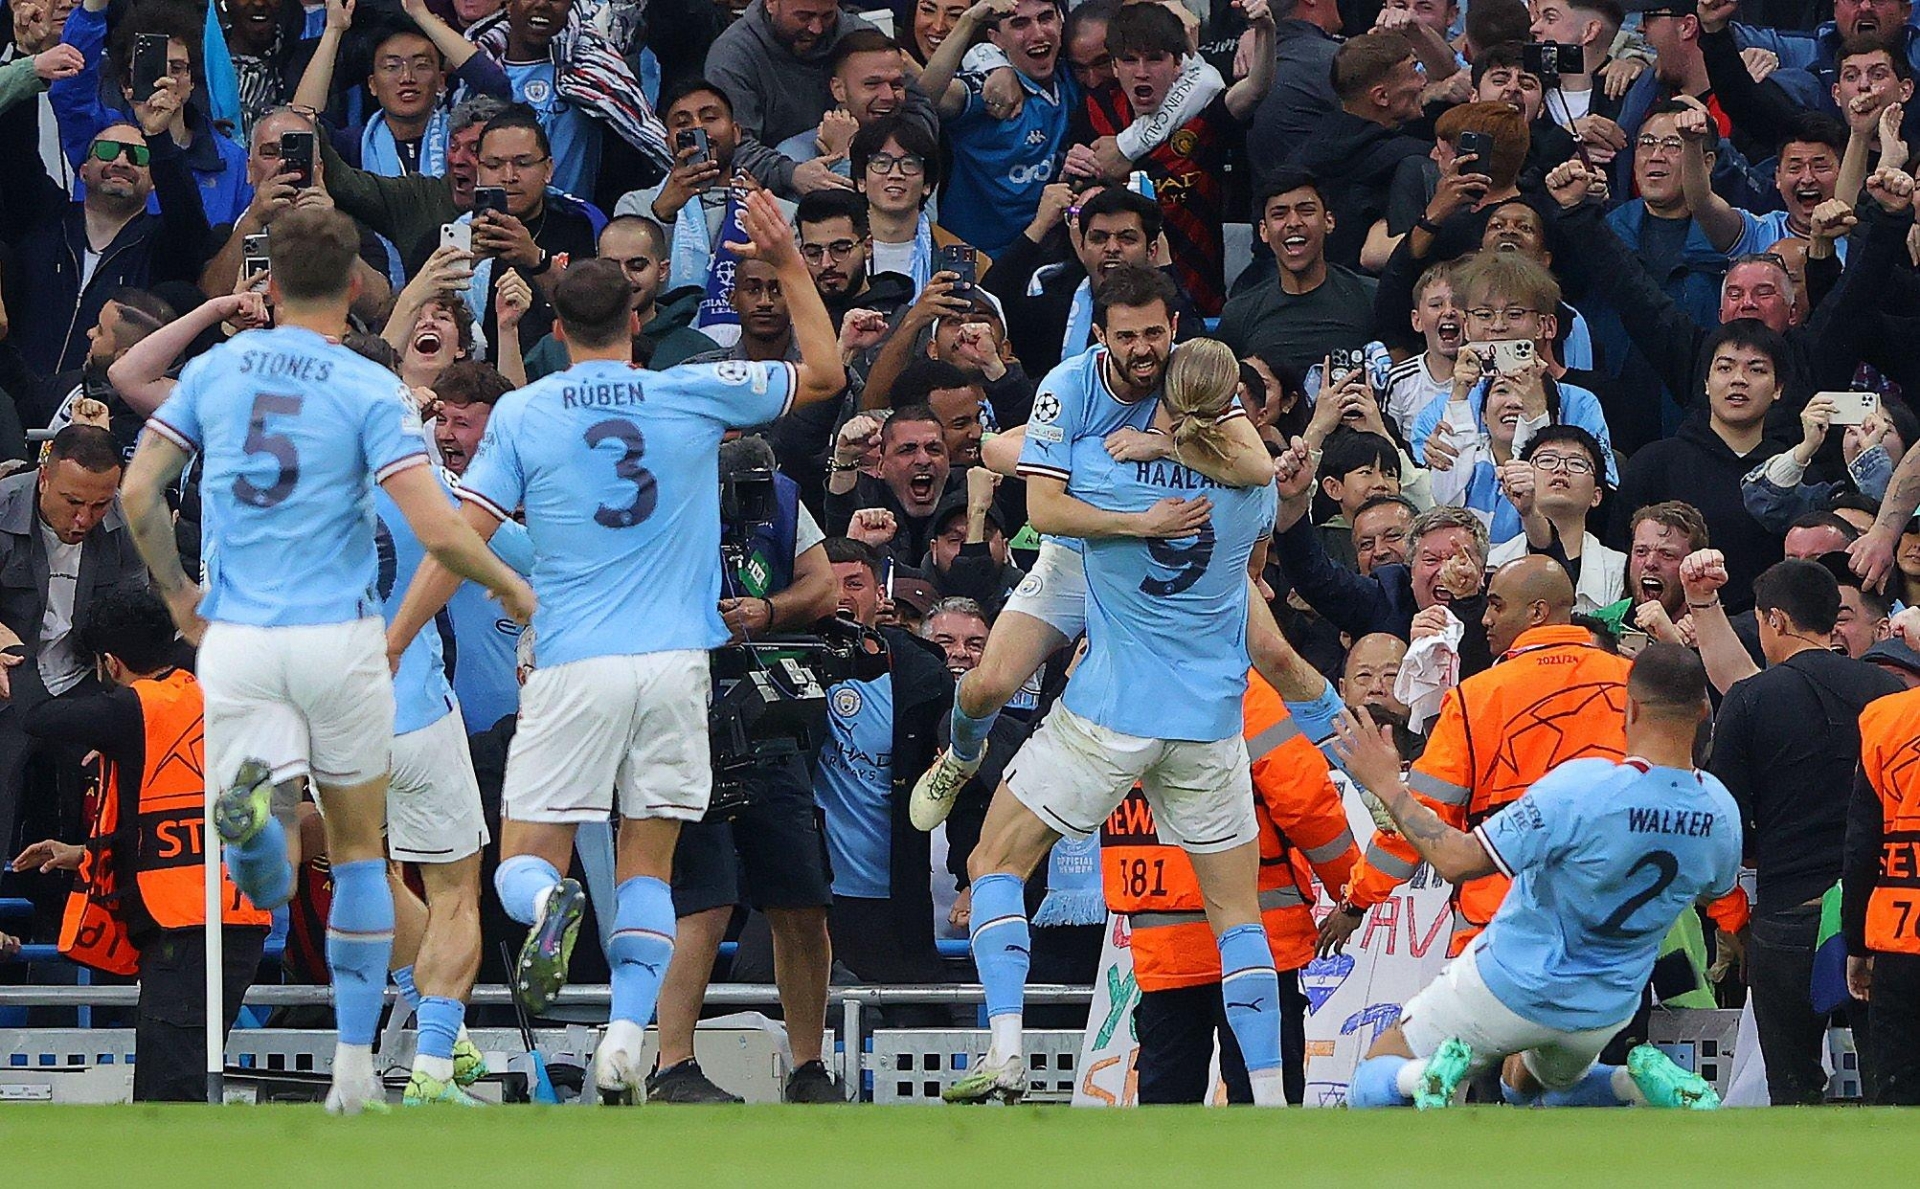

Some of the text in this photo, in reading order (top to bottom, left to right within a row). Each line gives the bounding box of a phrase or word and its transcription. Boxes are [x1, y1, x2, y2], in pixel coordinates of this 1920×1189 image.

[1162, 78, 1195, 114] KLEIN
[240, 349, 334, 381] STONES
[562, 377, 646, 410] RÚBEN
[231, 392, 305, 508] 5
[584, 417, 659, 529] 3
[1136, 461, 1230, 490] HAALA
[1138, 517, 1217, 598] 9
[1628, 807, 1714, 838] WALKER
[1056, 856, 1094, 866] OFFICIAL
[1583, 850, 1678, 942] 2
[1892, 900, 1920, 940] 7
